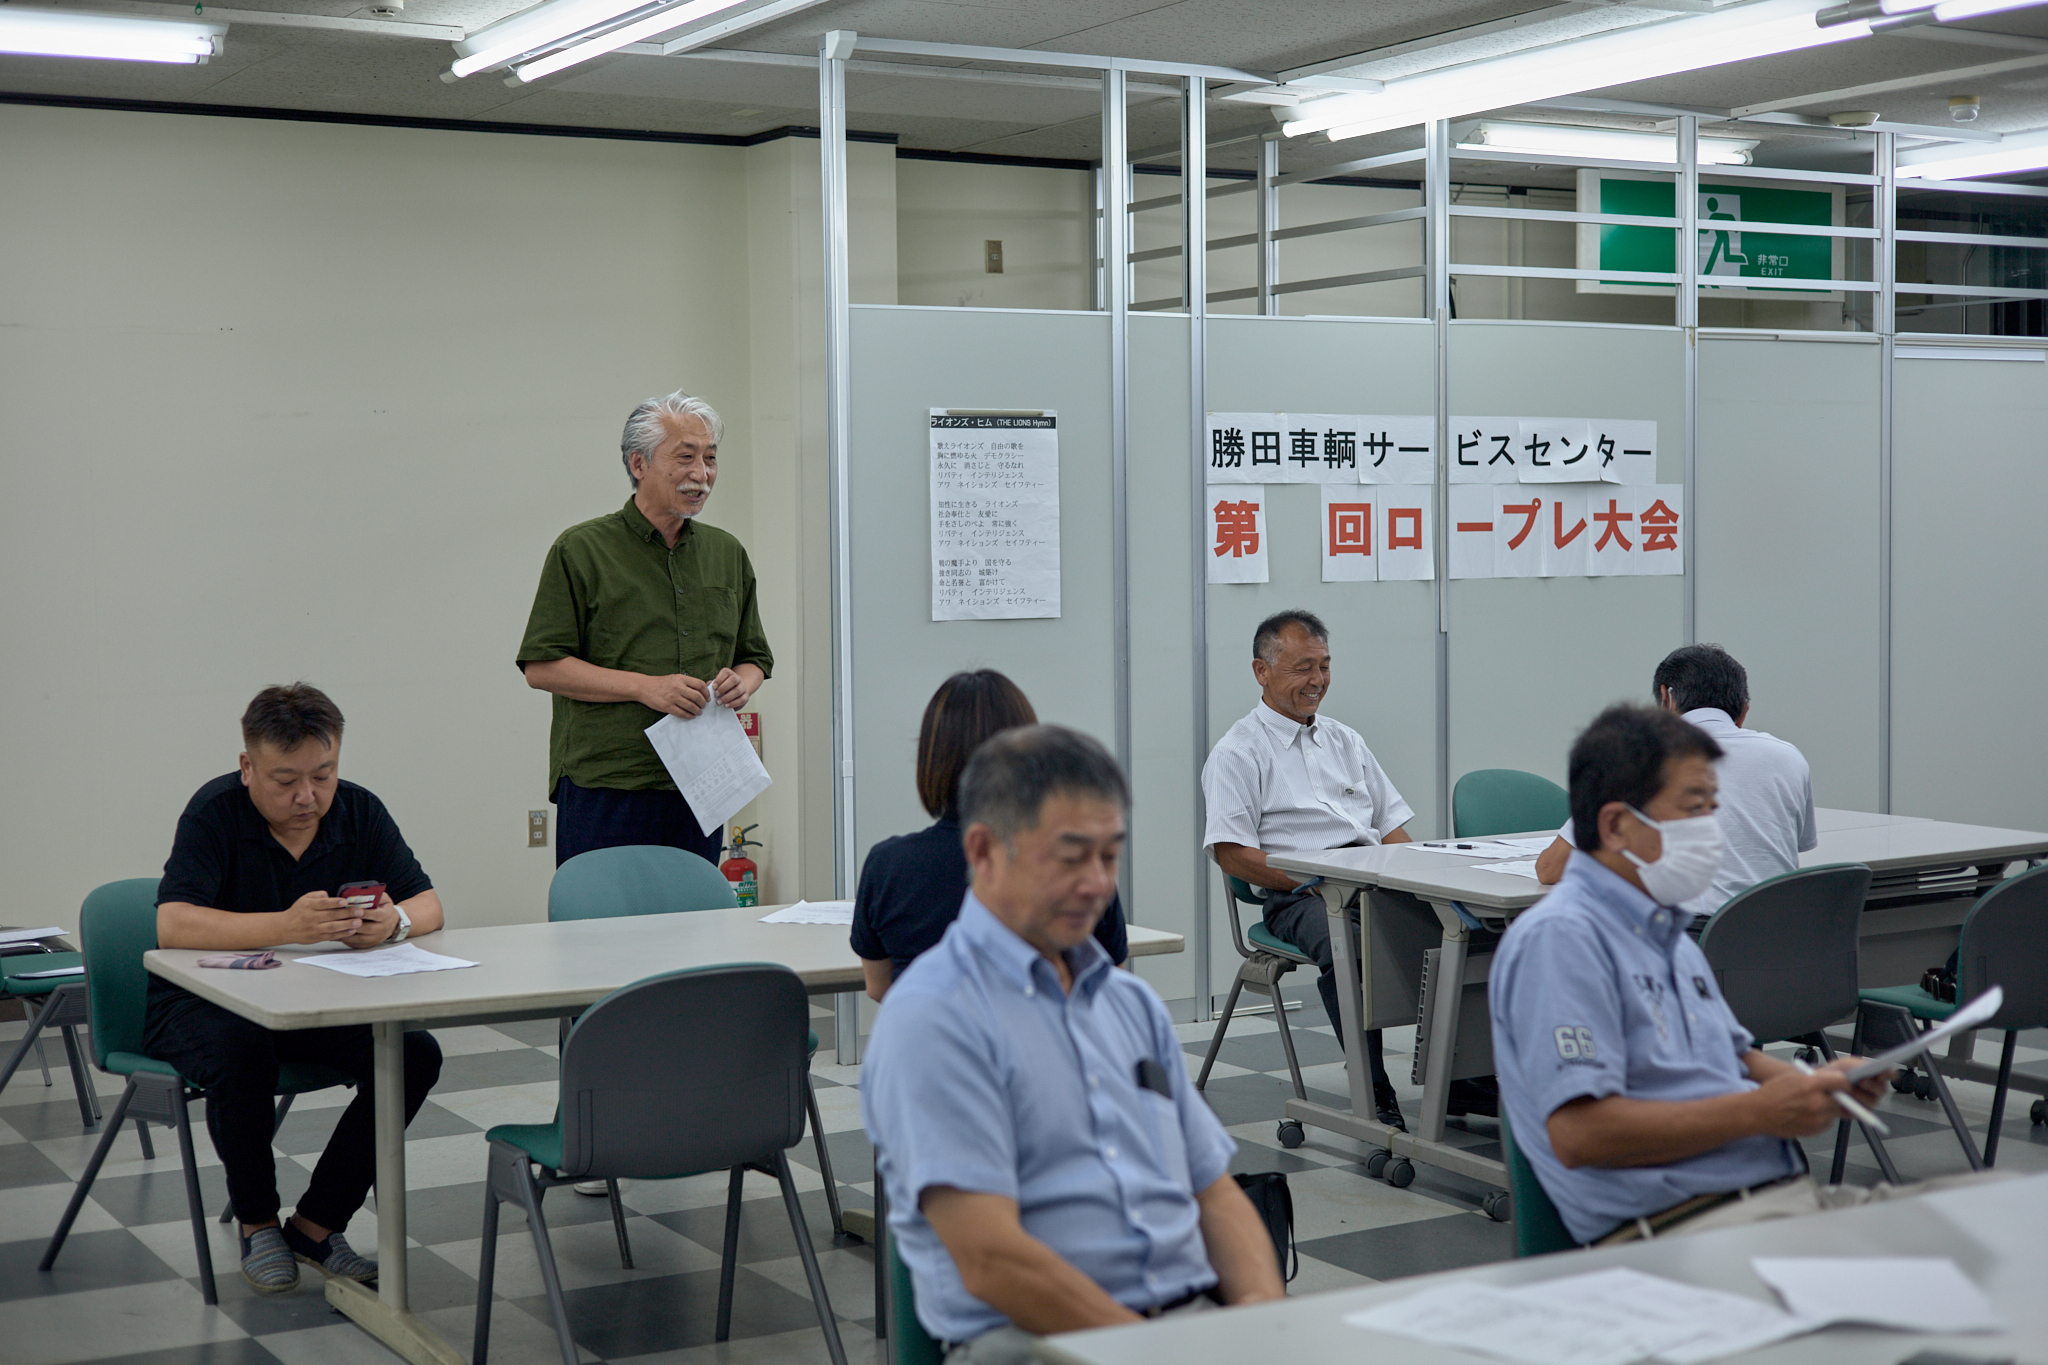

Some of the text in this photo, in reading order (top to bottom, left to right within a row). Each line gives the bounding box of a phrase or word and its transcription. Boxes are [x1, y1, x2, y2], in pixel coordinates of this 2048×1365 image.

[1757, 254, 1788, 266] 非常口
[1761, 267, 1783, 276] EXIT
[931, 418, 992, 427] ライオンズ・ヒム
[1553, 1025, 1597, 1059] 66
